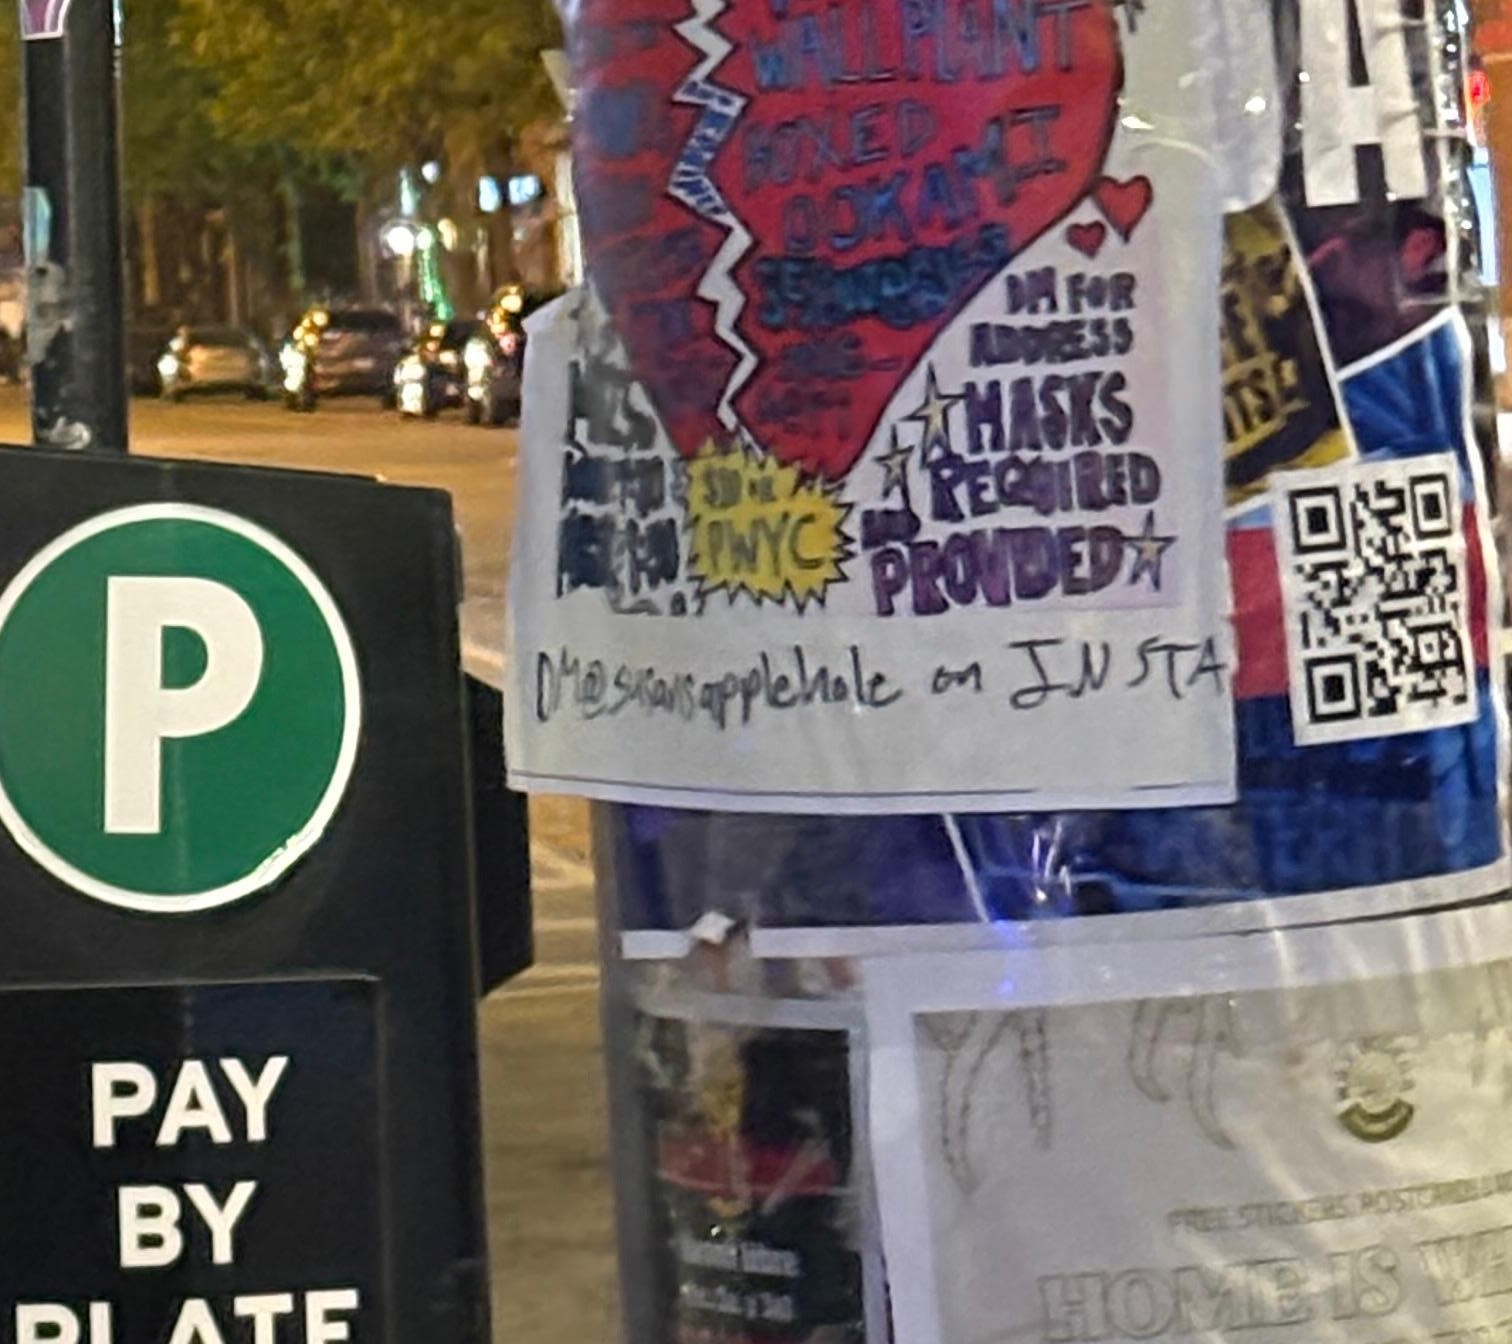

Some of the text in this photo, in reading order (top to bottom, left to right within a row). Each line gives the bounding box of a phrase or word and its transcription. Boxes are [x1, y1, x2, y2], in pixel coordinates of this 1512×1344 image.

[1066, 272, 1137, 313] FOR
[964, 371, 1135, 455] MASKS
[929, 449, 1163, 523] REQUIRED
[871, 525, 1126, 617] PROVIDED
[103, 575, 264, 835] P
[91, 1055, 289, 1148] PAY
[117, 1181, 257, 1270] BY
[1037, 1256, 1312, 1343] HOME
[1326, 1242, 1405, 1322] IS
